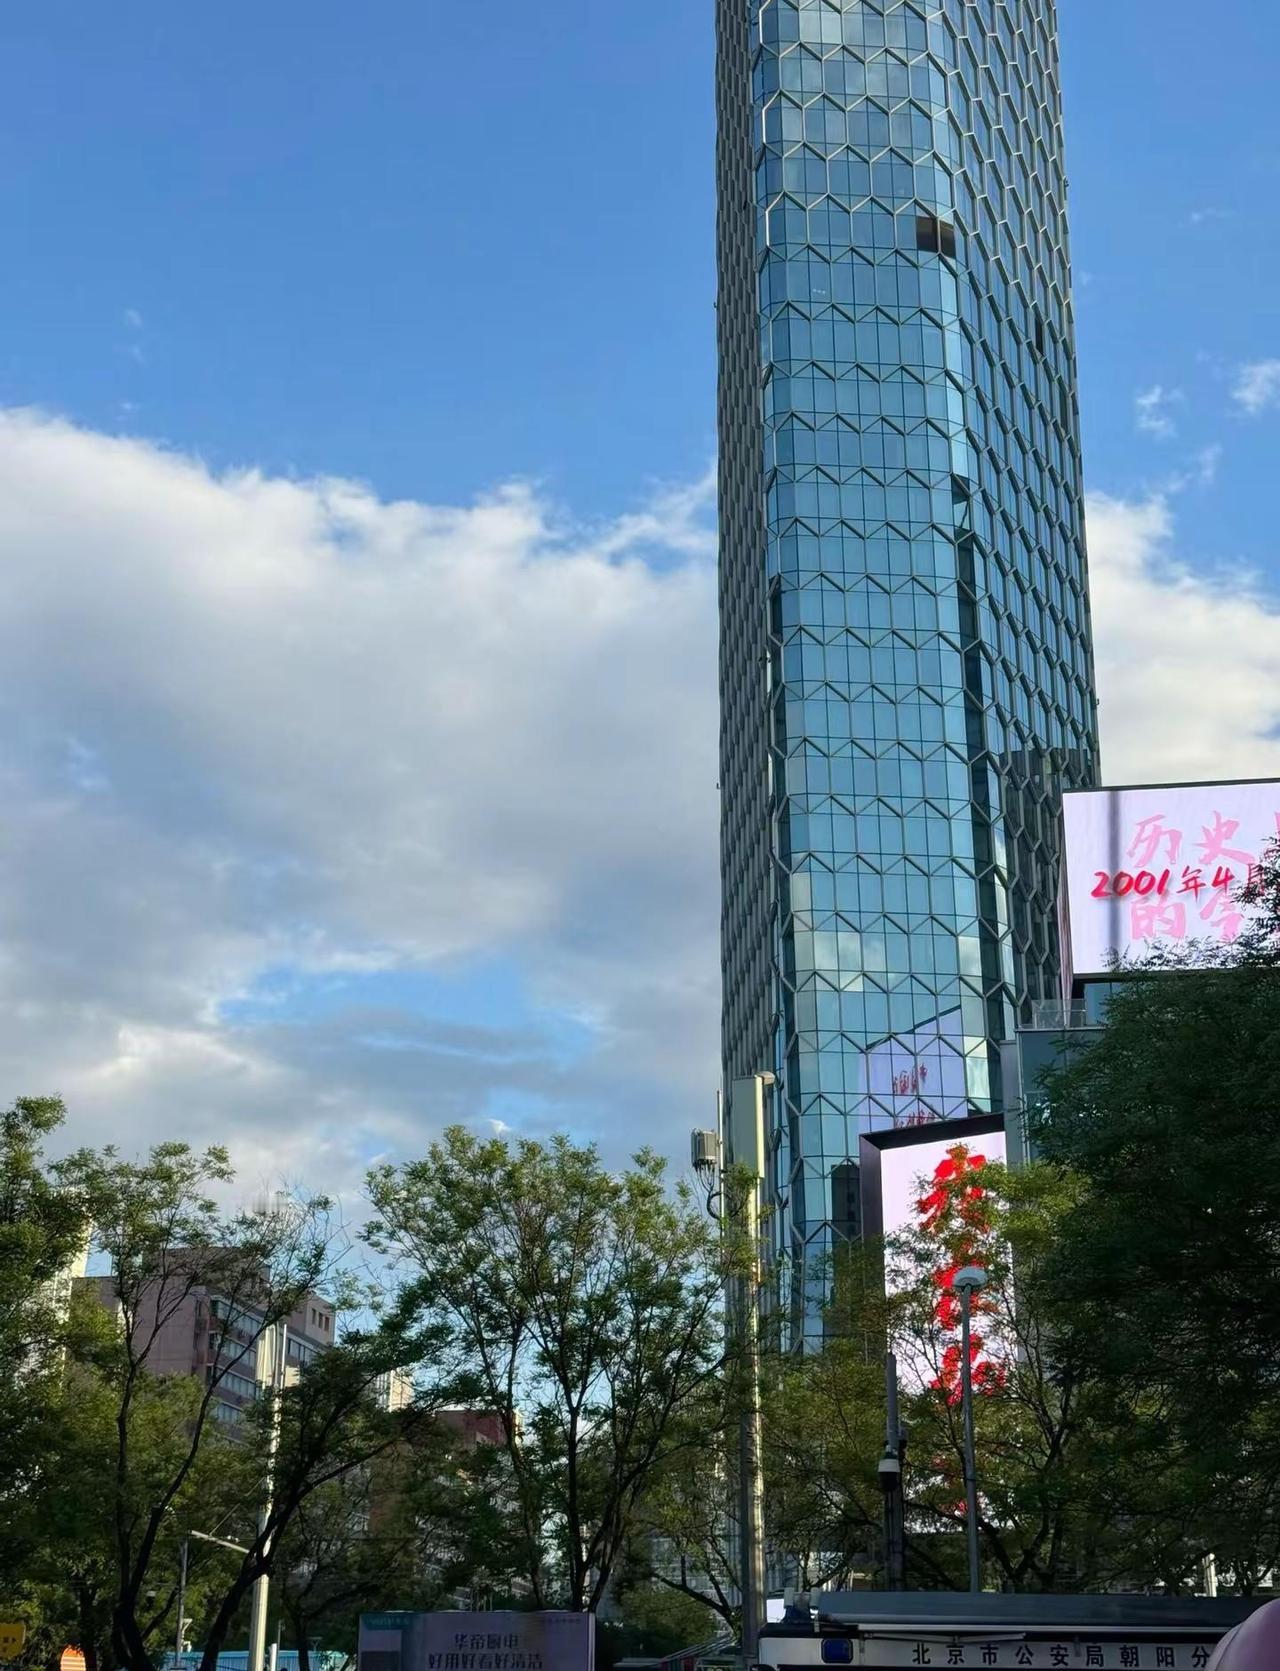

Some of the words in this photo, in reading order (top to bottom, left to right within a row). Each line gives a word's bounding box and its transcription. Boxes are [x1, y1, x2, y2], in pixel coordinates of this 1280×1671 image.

[1126, 811, 1280, 867] 历史
[912, 1642, 1210, 1668] 北京市公安局朝阳分
